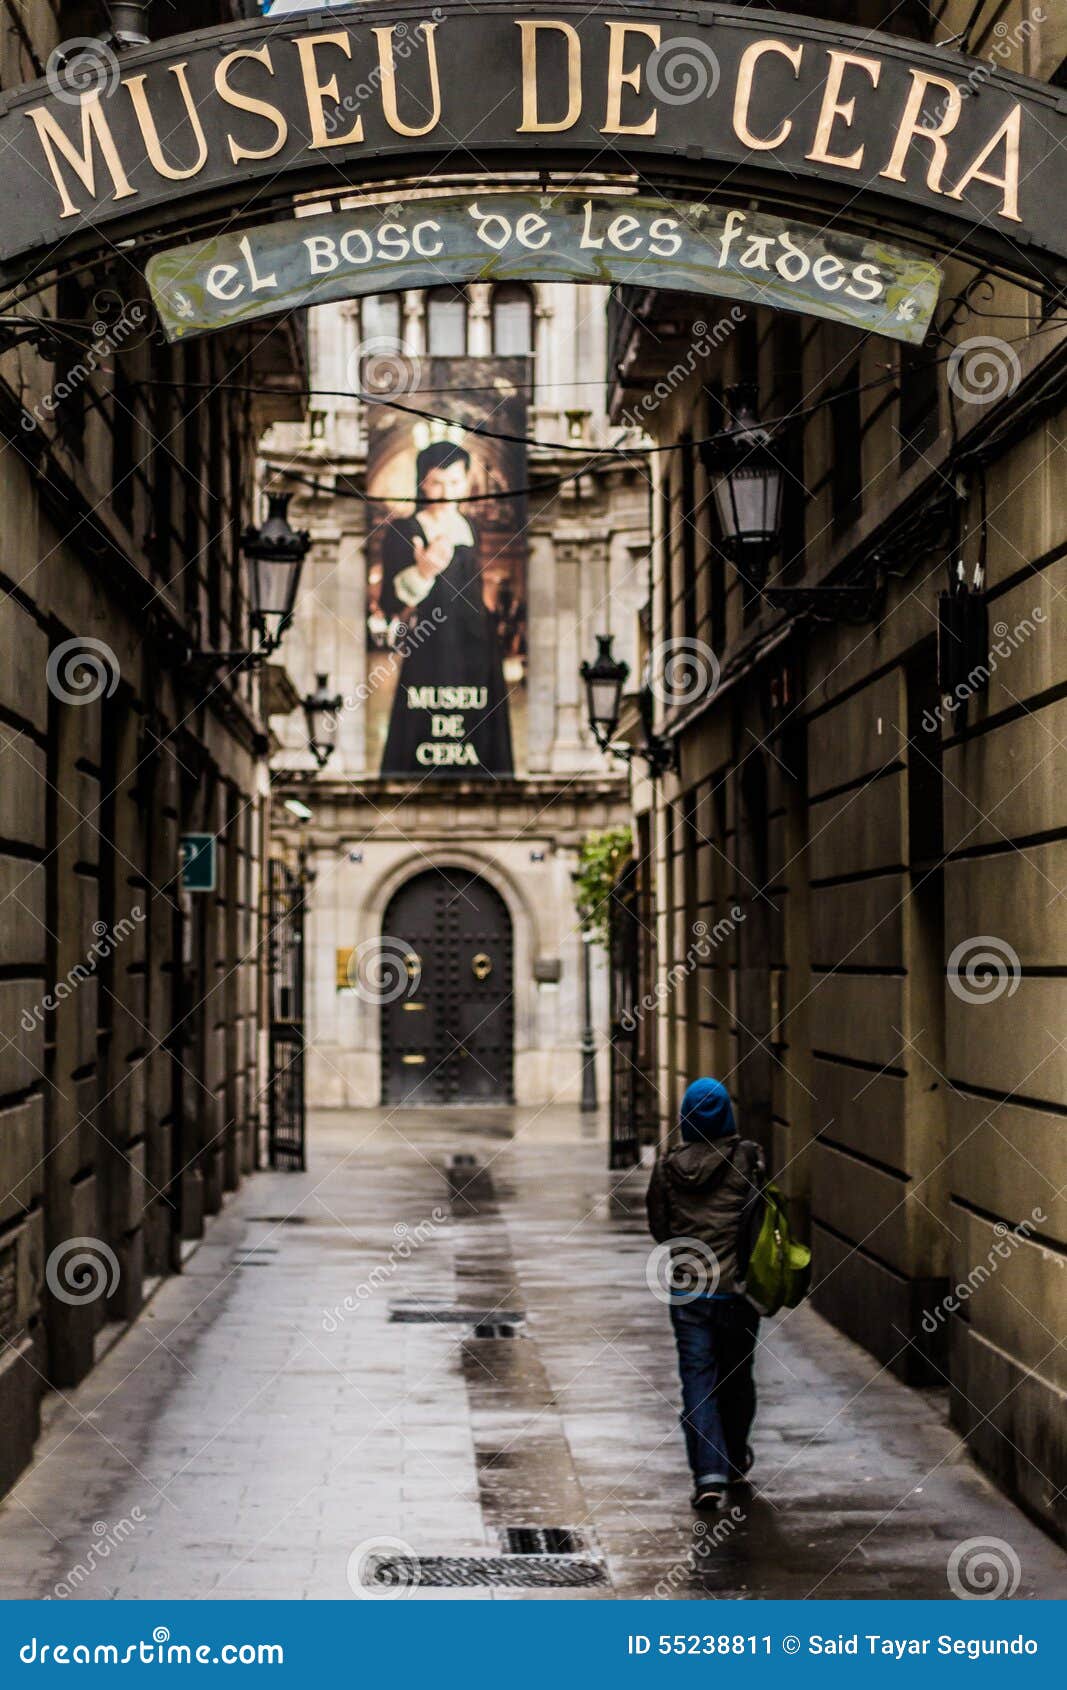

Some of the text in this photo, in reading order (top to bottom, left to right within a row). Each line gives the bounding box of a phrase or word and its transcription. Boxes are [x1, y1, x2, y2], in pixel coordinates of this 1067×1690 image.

[25, 20, 1023, 223] MUSEU DE CERA
[303, 219, 444, 276] BOSC
[406, 685, 489, 710] MUSEU
[431, 713, 466, 738] DE
[415, 741, 480, 766] CERA
